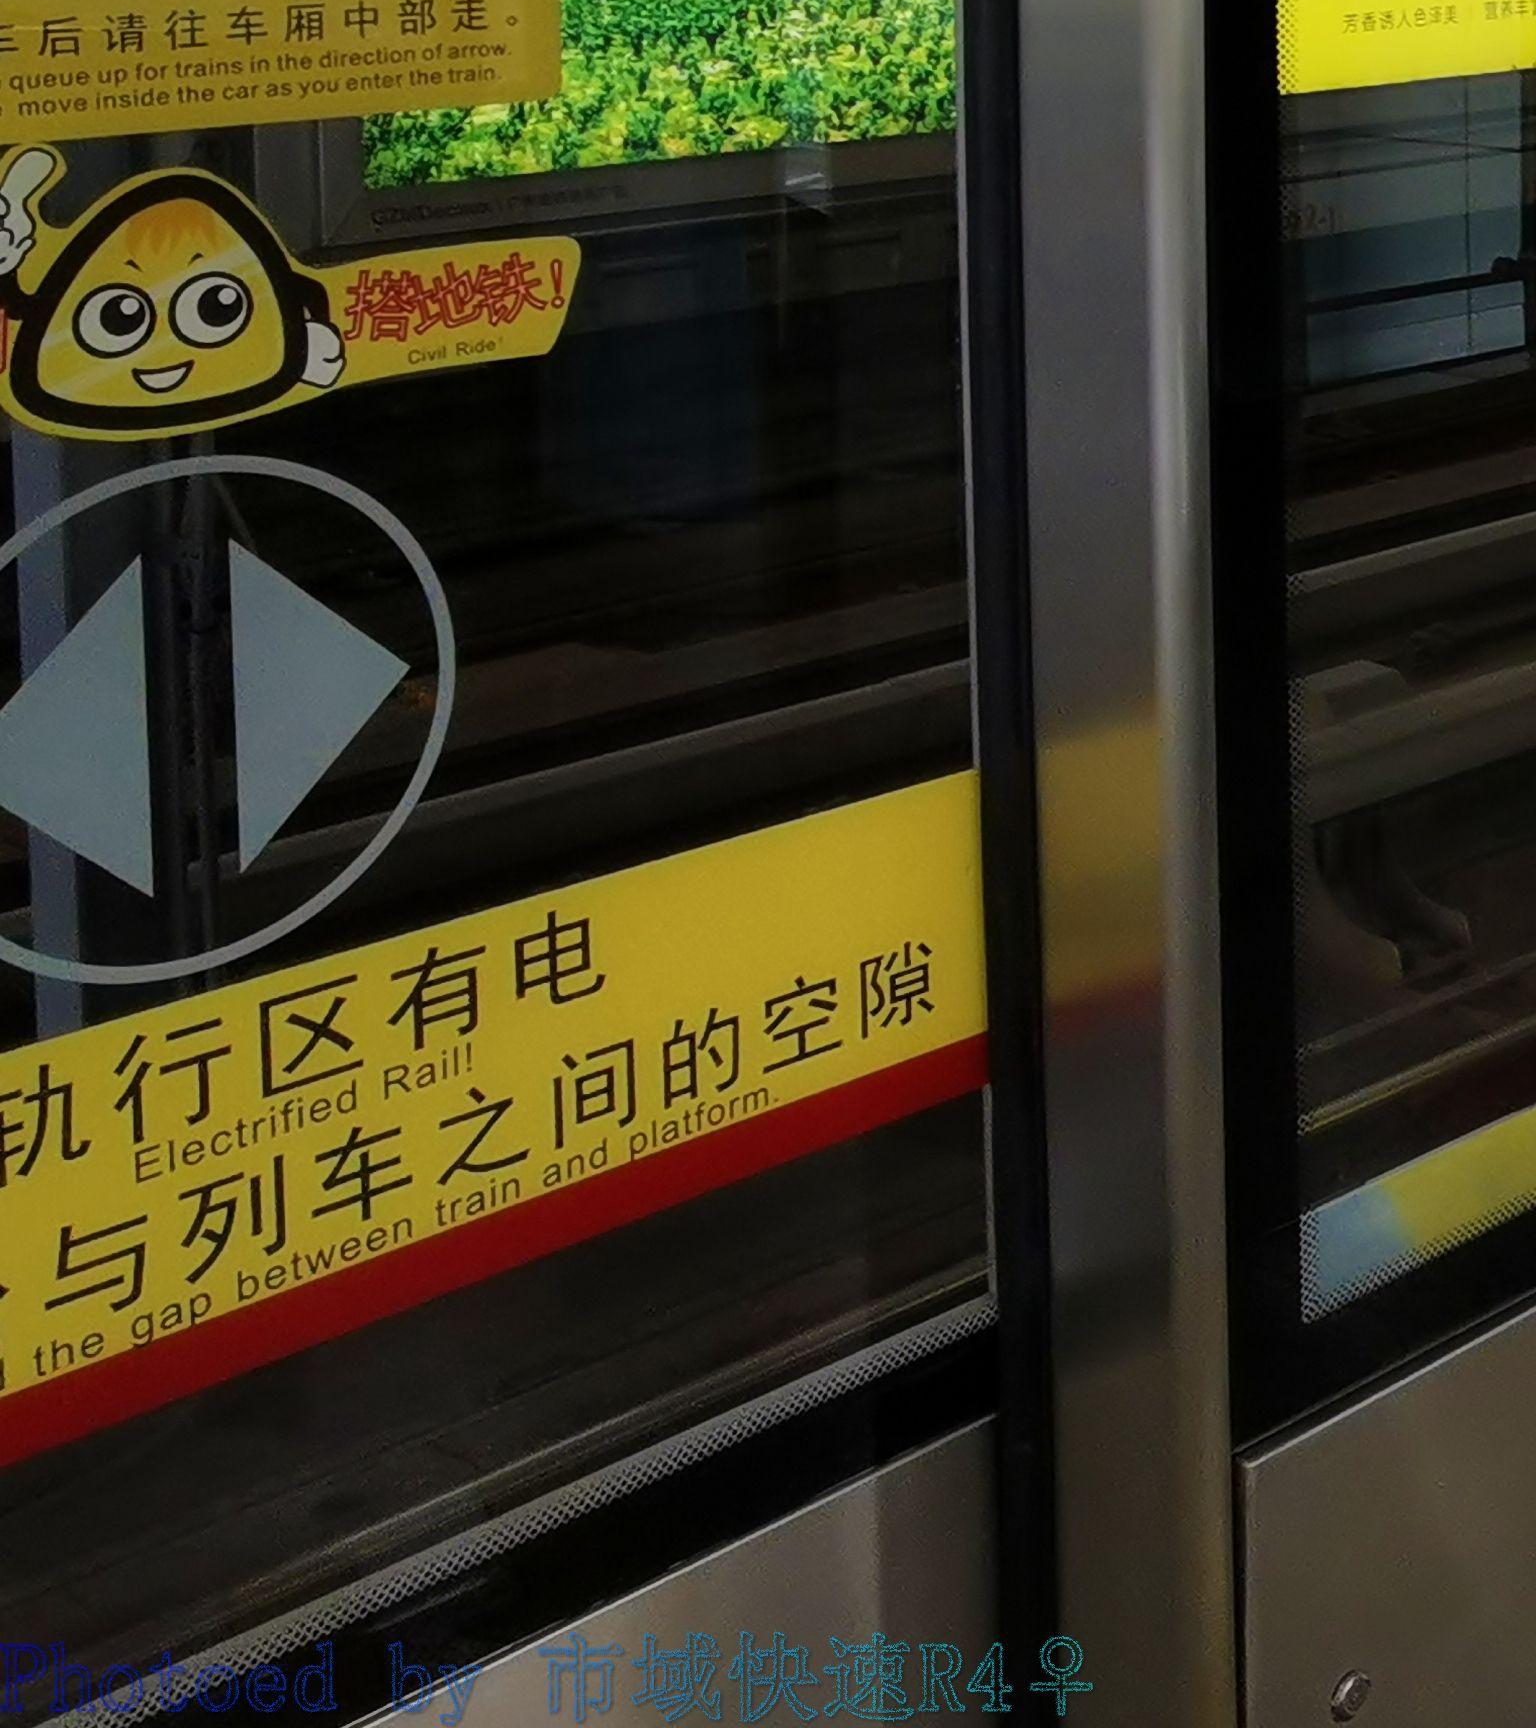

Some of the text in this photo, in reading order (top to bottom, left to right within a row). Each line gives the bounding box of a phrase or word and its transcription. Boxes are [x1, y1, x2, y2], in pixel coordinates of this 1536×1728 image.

[9, 41, 512, 95] queue up for trains in the direction of arrow.
[18, 95, 89, 116] move
[96, 86, 170, 110] inside
[177, 85, 215, 104] the
[222, 83, 259, 100] car
[265, 82, 293, 98] as
[298, 77, 340, 100] you
[345, 72, 403, 92] enter
[409, 69, 443, 87] the
[343, 251, 566, 343] 搭地铁！
[407, 346, 447, 365] Civil
[0, 909, 607, 1189] 轨行区有电
[0, 939, 936, 1313] 与列车之间的空隙
[134, 1041, 475, 1185] Electrified Rail!
[34, 1331, 106, 1378] the
[131, 1291, 213, 1350] gap
[237, 1215, 414, 1303] between
[435, 1174, 522, 1228] train
[542, 1138, 609, 1189] and
[628, 1083, 781, 1164] platform.
